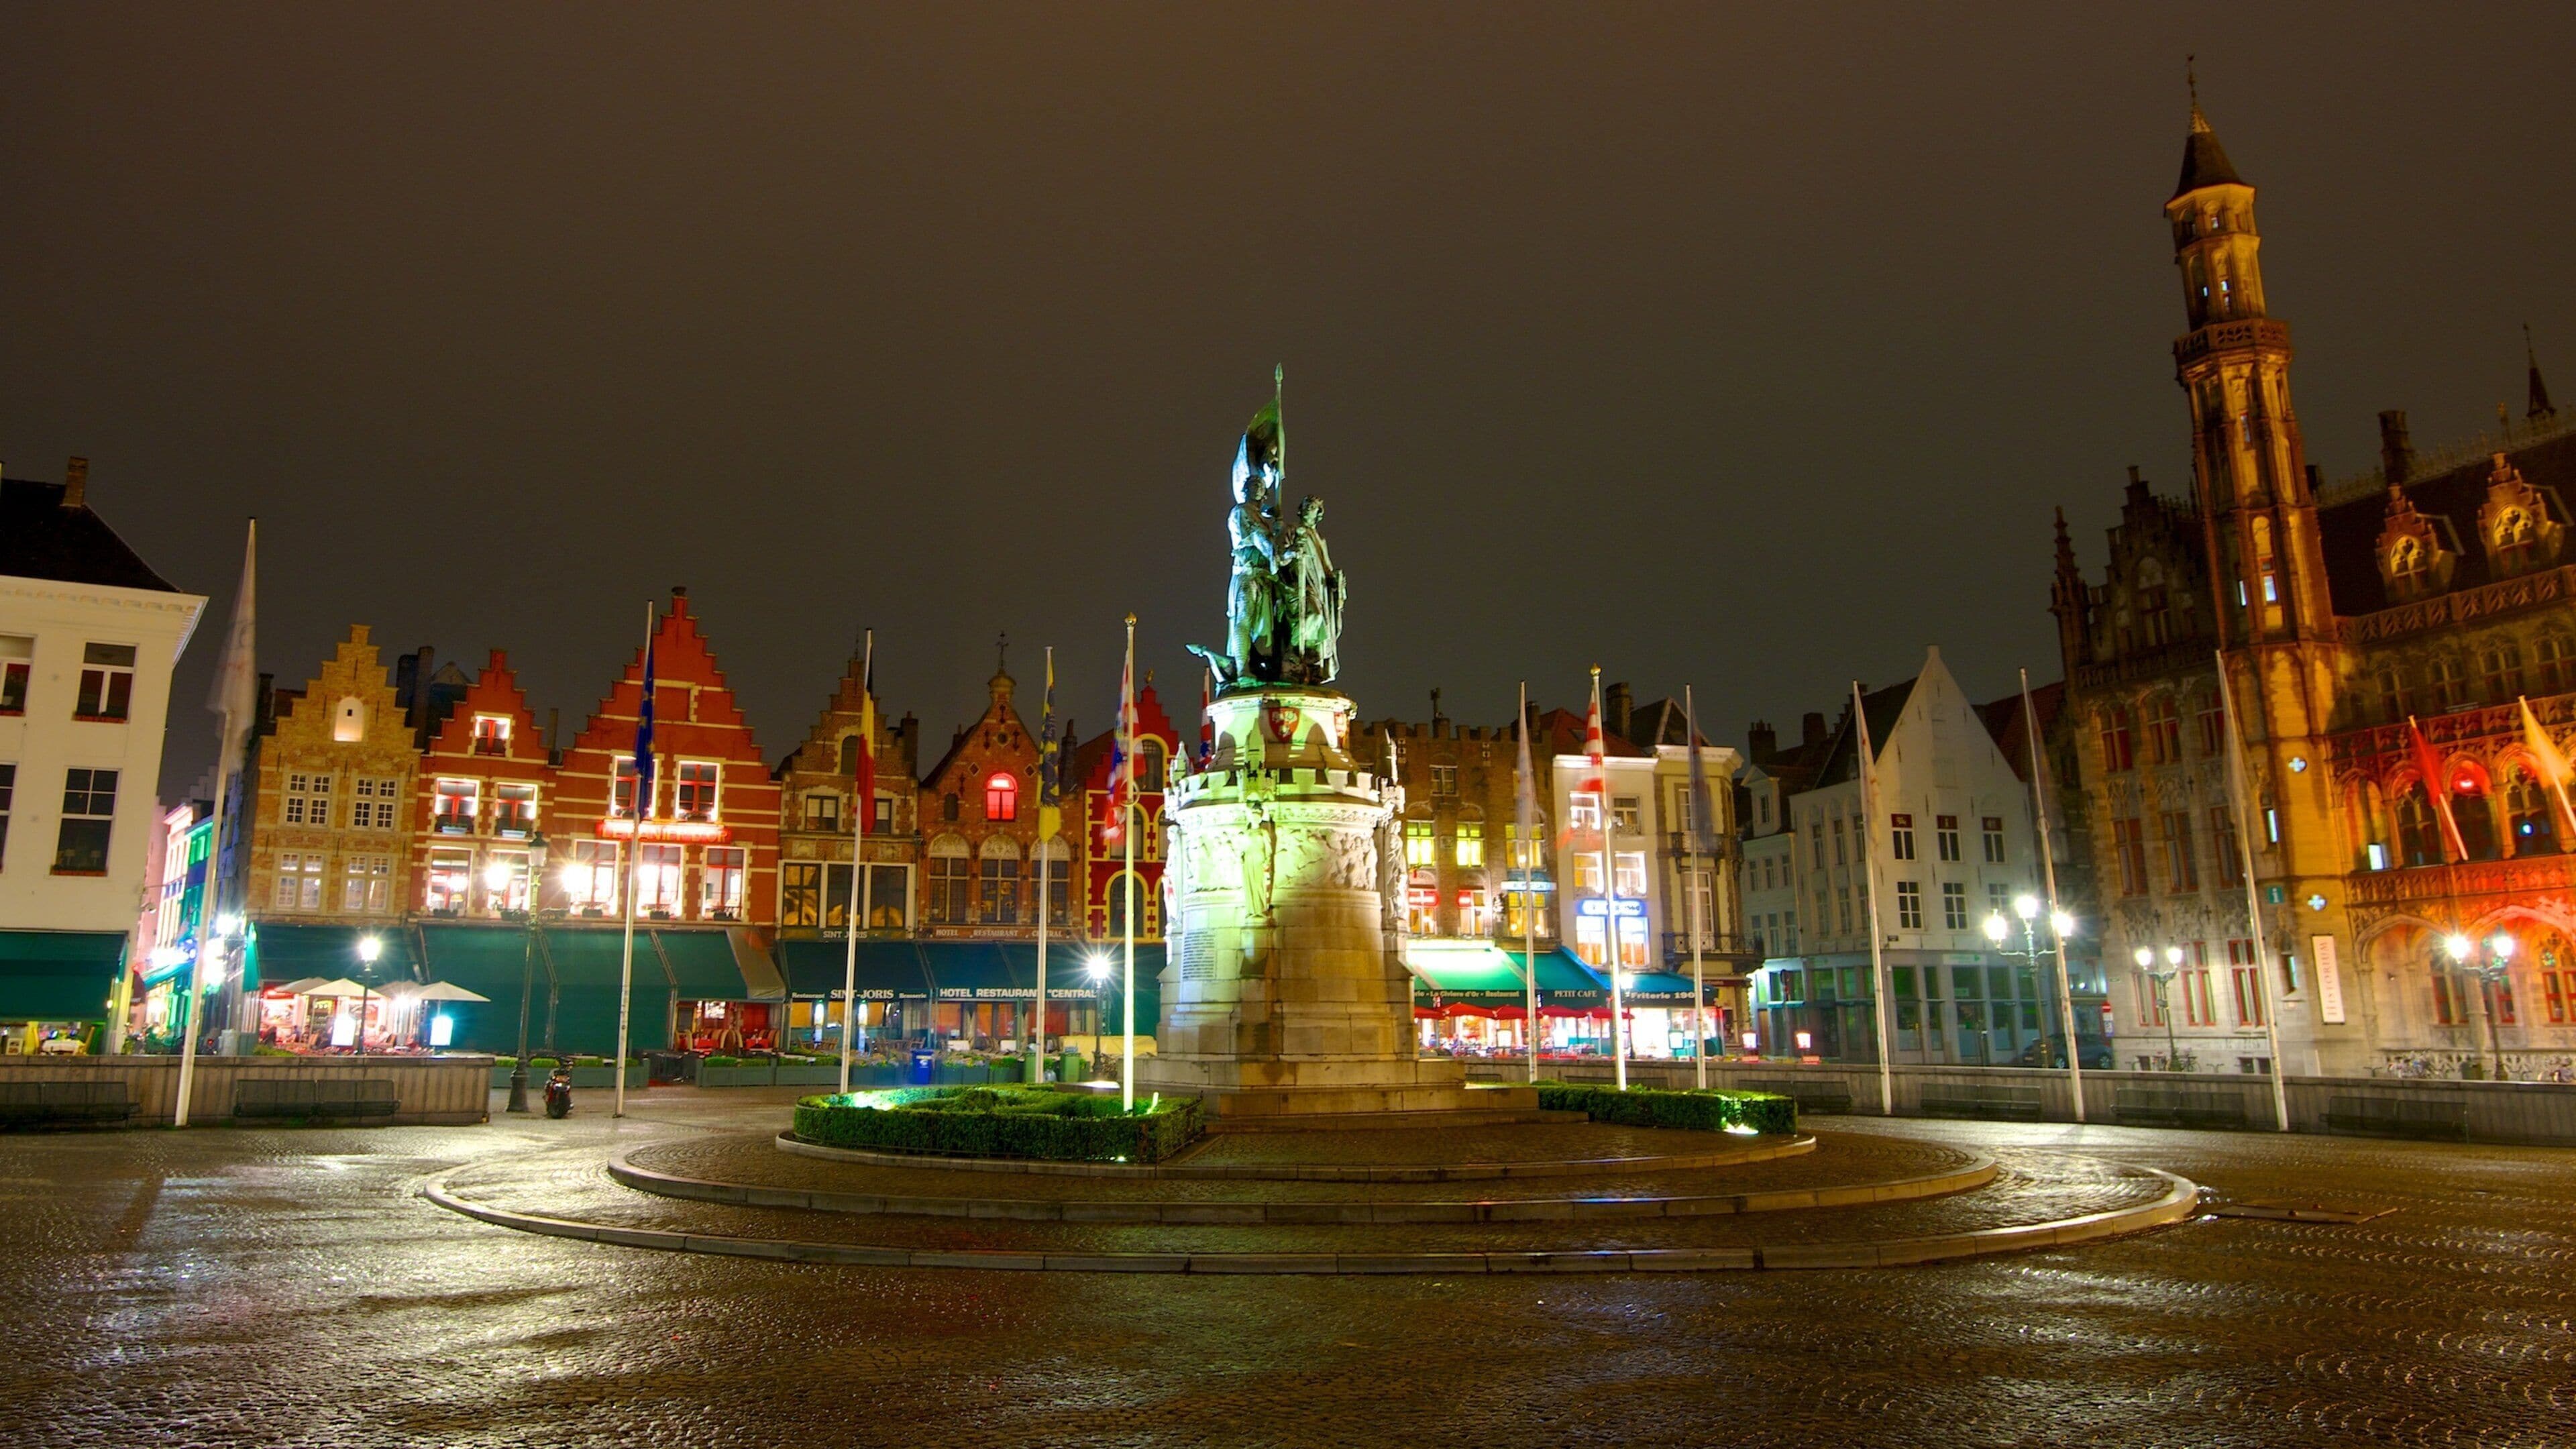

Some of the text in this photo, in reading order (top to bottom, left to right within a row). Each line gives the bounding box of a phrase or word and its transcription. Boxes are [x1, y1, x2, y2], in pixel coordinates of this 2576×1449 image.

[823, 930, 842, 938] SINT
[940, 988, 972, 998] HOTEL
[976, 988, 1038, 998] RESTAURAN
